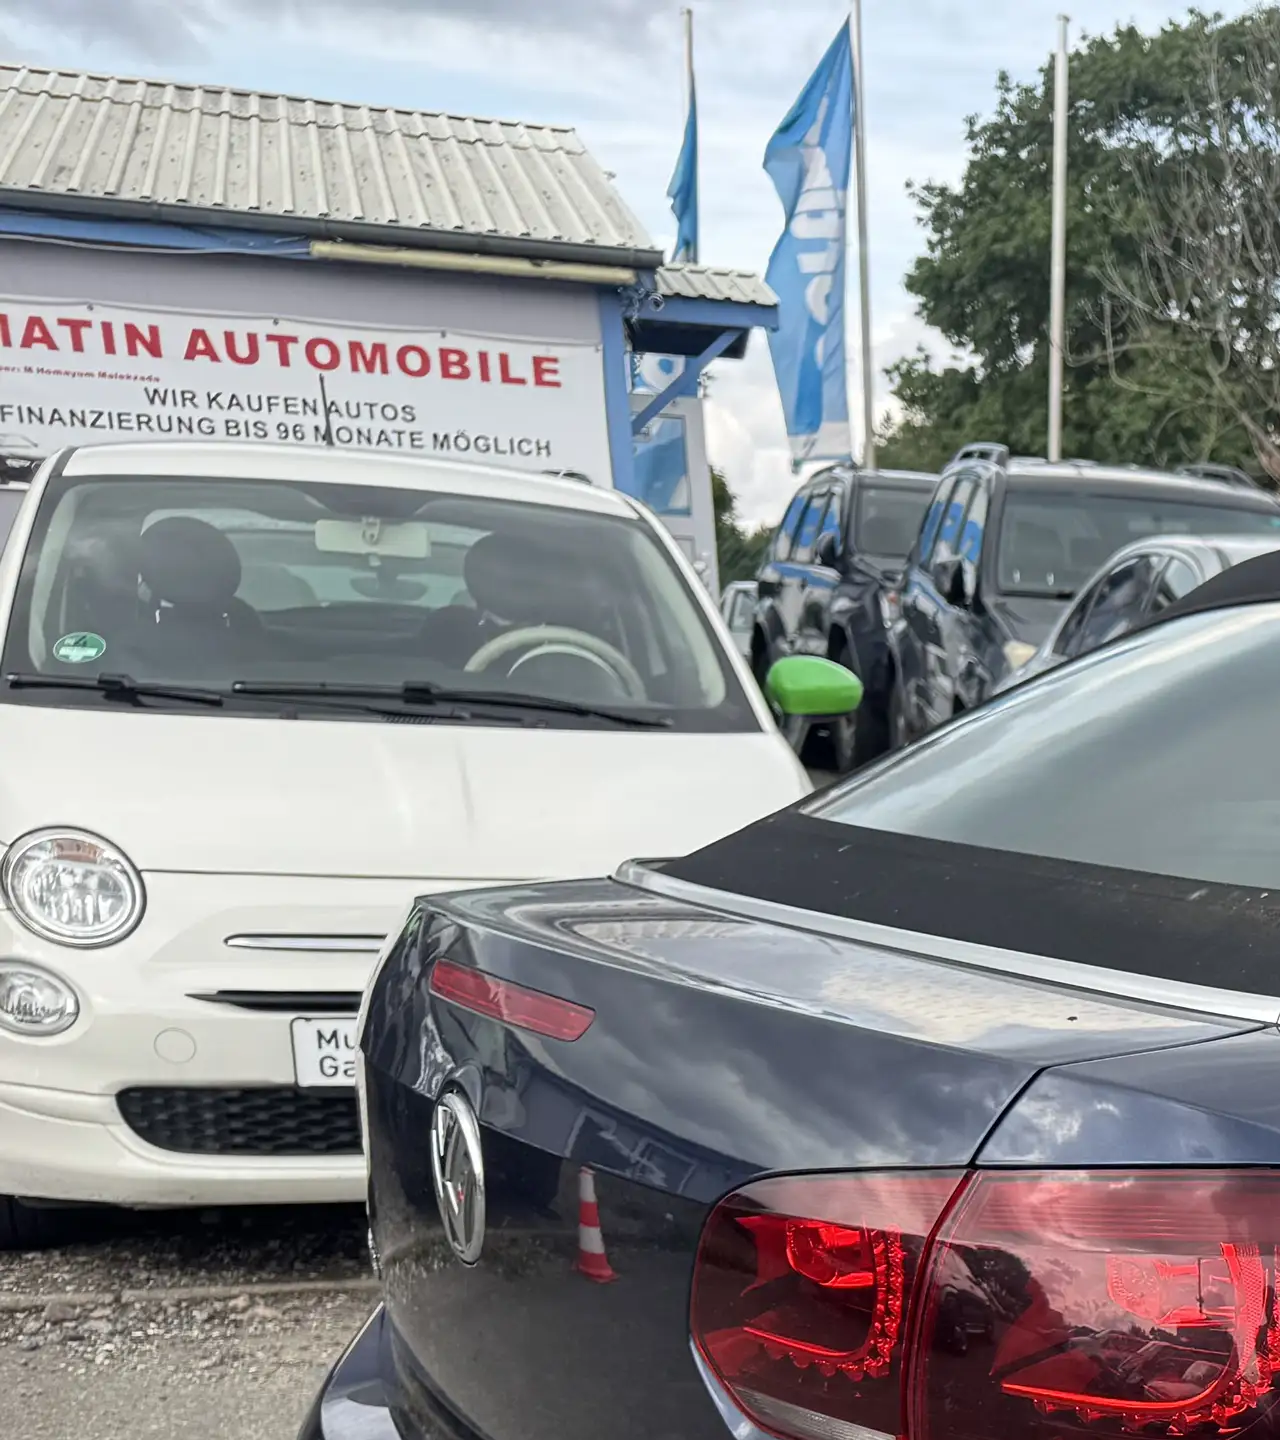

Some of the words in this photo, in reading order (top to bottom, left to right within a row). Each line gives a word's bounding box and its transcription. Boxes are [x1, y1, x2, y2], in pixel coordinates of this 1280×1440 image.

[183, 328, 562, 388] AUTOMOBILE
[0, 404, 216, 436] FINANZIERUNG
[225, 419, 268, 439] BIS
[276, 424, 305, 442] 96
[314, 425, 424, 450] MONATE
[433, 429, 552, 457] MÖGLICH
[144, 386, 198, 409] WIR
[206, 391, 317, 417] KAUFEN
[327, 400, 416, 423] AUTOS
